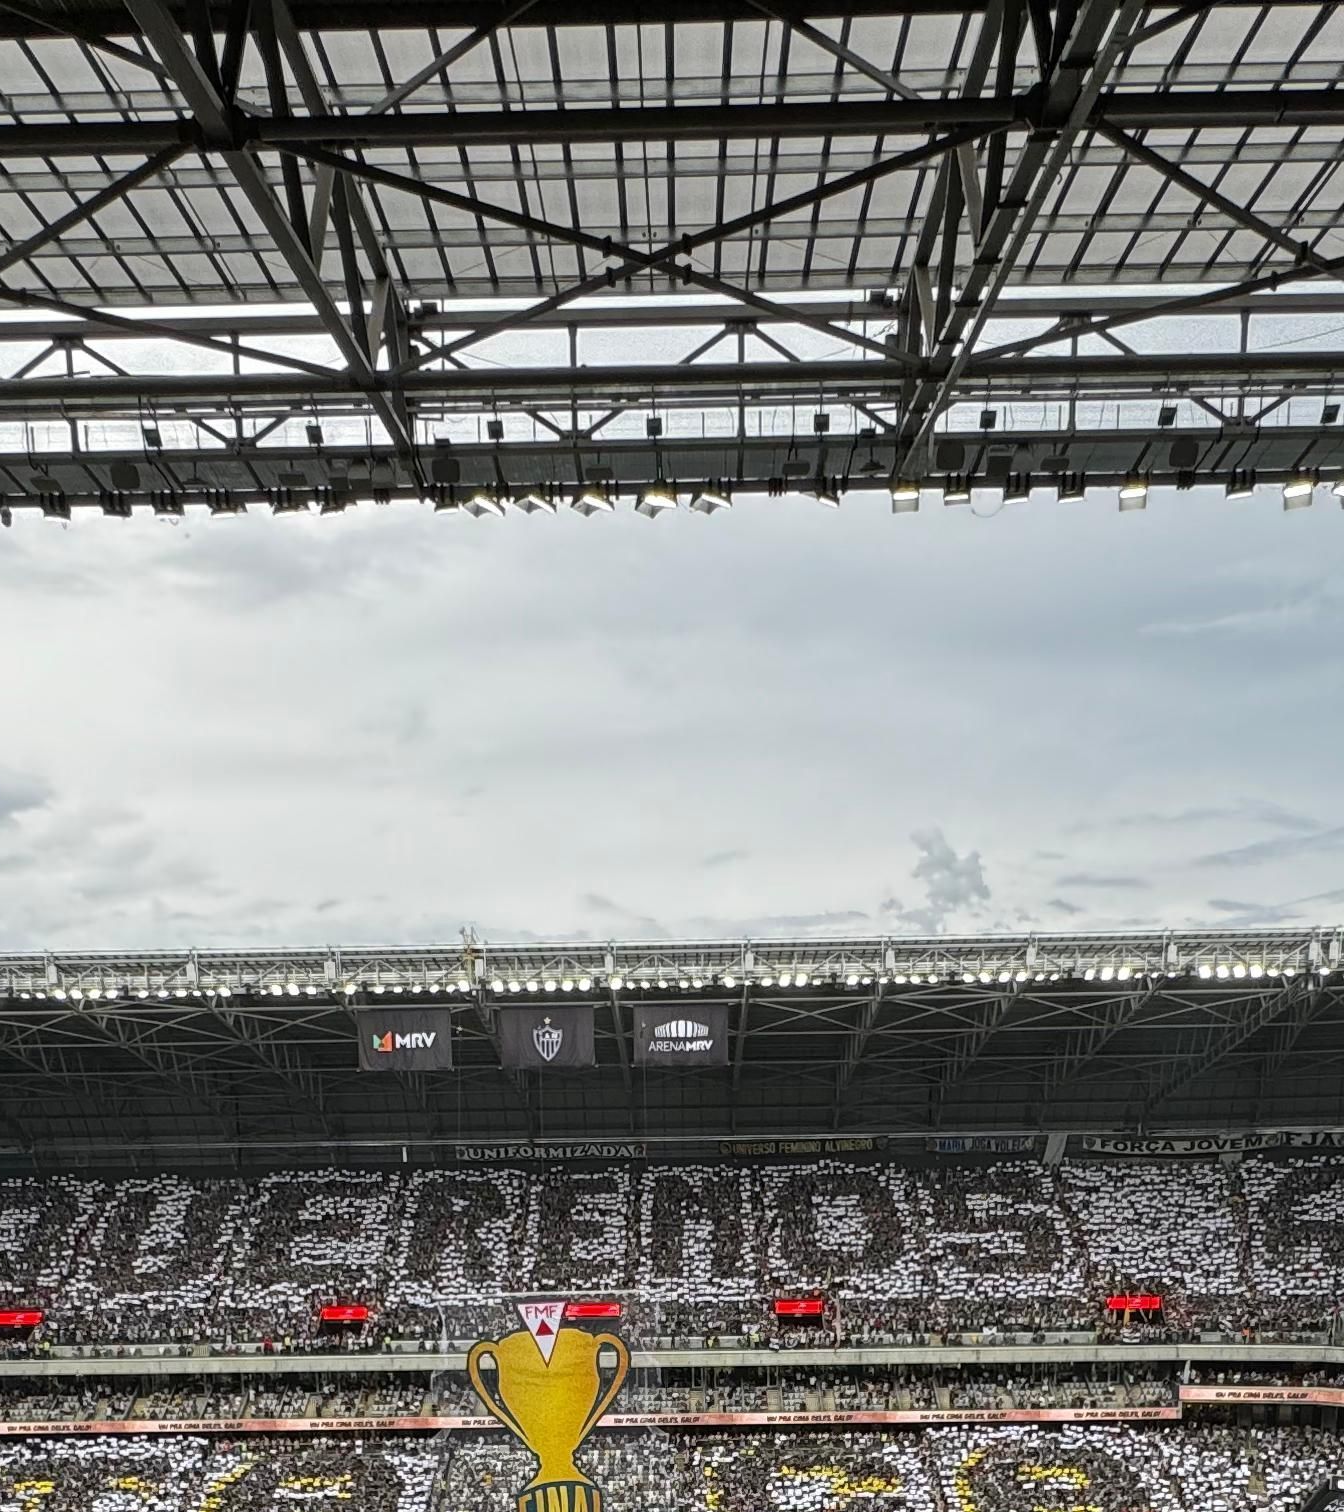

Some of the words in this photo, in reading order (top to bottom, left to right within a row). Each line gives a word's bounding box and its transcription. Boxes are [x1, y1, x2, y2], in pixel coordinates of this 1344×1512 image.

[395, 1032, 436, 1048] MRV
[468, 1144, 634, 1160] UNIFORMIZADA
[732, 1141, 775, 1153] UNIVERSO
[779, 1140, 821, 1152] FEMININO
[825, 1138, 873, 1152] ALVINEGRO
[1101, 1139, 1176, 1153] FORÇA
[1183, 1136, 1262, 1151] JOVEM
[525, 1306, 556, 1320] FMF
